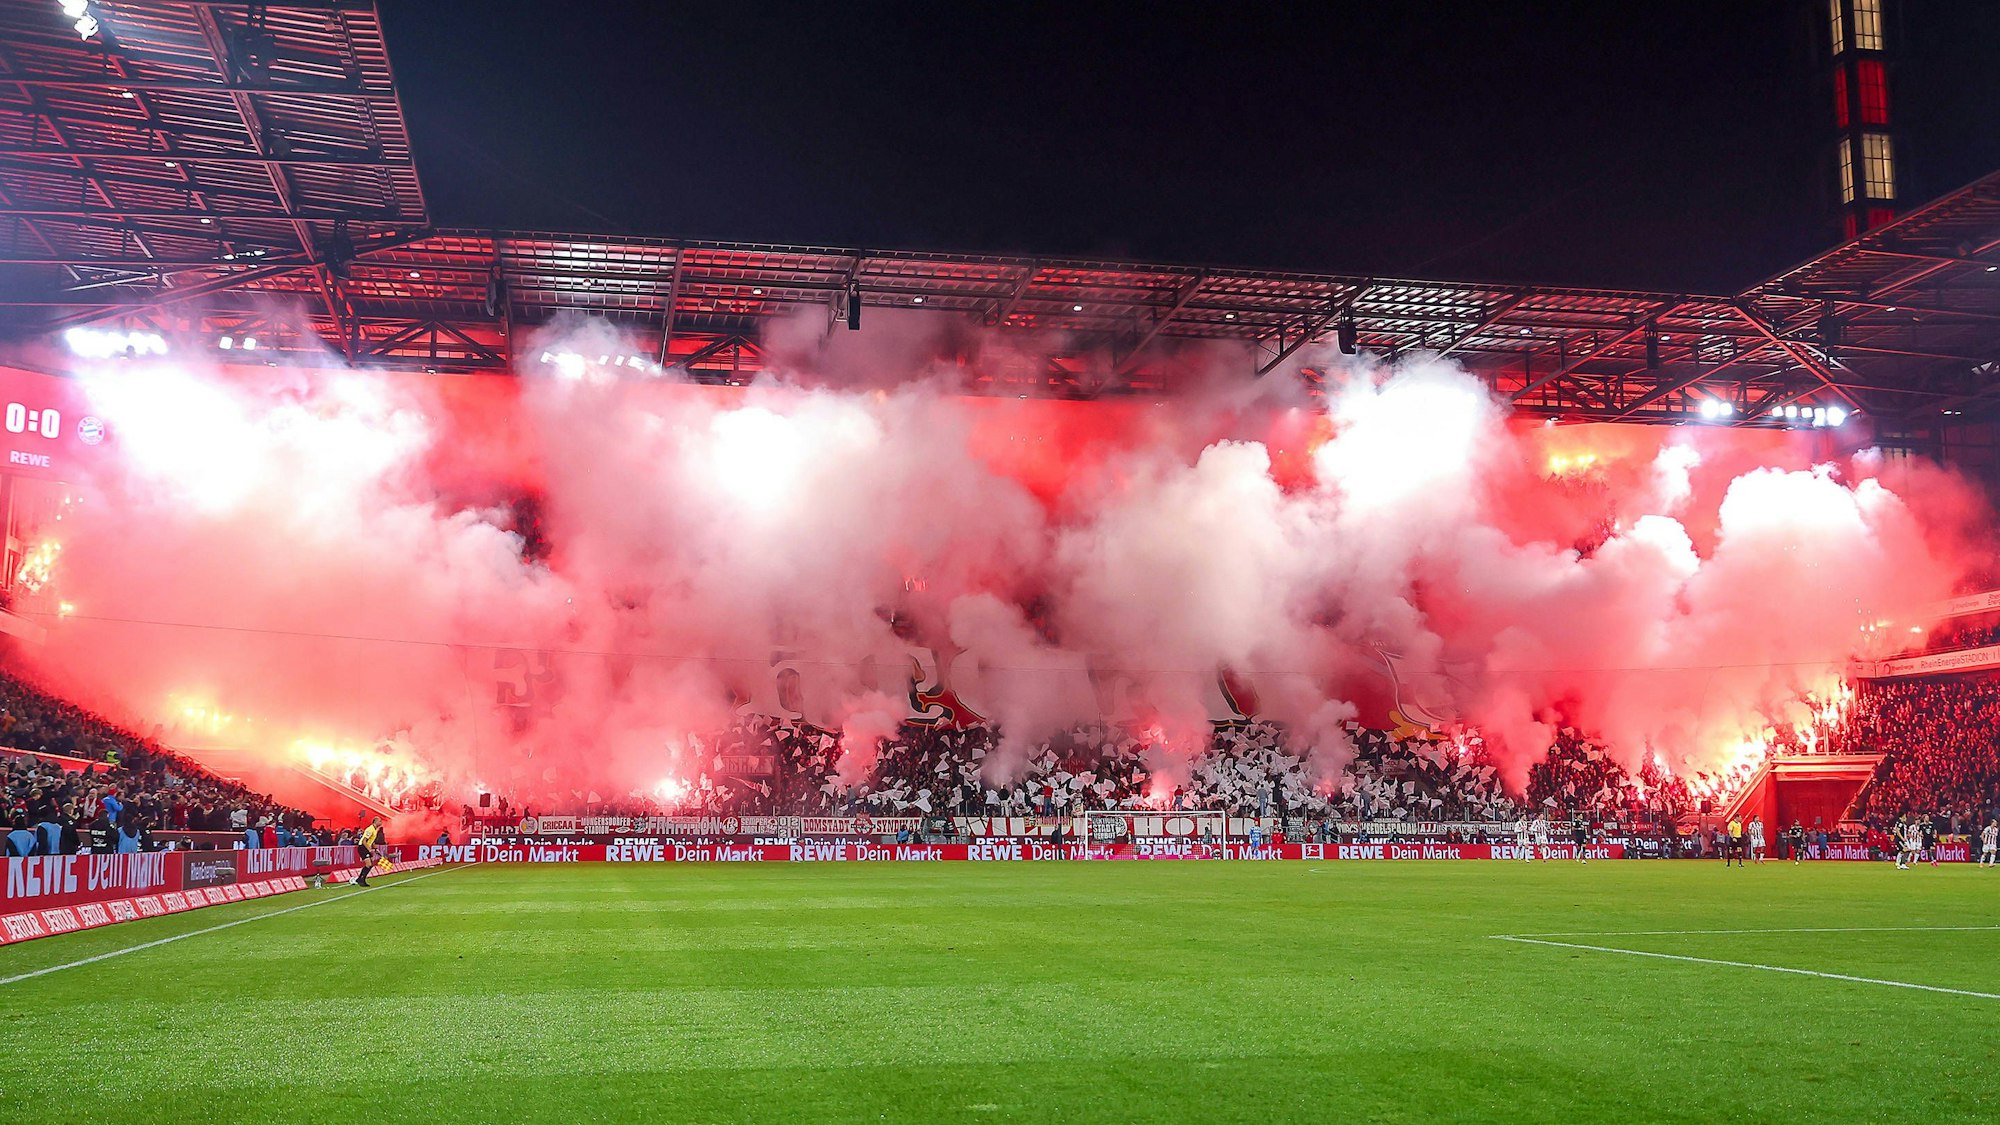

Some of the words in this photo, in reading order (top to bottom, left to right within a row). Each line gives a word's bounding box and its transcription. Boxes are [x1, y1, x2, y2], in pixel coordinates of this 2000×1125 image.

[5, 402, 60, 438] 0:0
[10, 450, 50, 467] REWE
[1921, 652, 1988, 668] RheinEnergieSTADION
[543, 820, 573, 830] CRICCAA
[740, 817, 768, 826] SEMPER
[803, 819, 850, 833] DOMSTADT
[1092, 824, 1116, 833] STADT
[1419, 823, 1436, 833] AJJ
[584, 825, 610, 835] STADION
[417, 845, 477, 863] REWE
[486, 845, 523, 862] Dein
[527, 845, 580, 863] Markt
[605, 845, 665, 862] REWE
[675, 844, 710, 862] Dein
[715, 846, 764, 862] Markt
[789, 845, 846, 861] REWE
[856, 845, 891, 861] Dein
[895, 846, 943, 861] Markt
[967, 845, 1023, 861] REWE
[1339, 846, 1385, 860] REWE
[1391, 846, 1419, 860] Dein
[1422, 846, 1460, 860] Markt
[1843, 845, 1869, 860] Markt
[1935, 847, 1966, 862] Markt
[41, 908, 81, 933] DERTOUR
[76, 903, 112, 927] DERTOUR
[2, 912, 46, 940] DERTOUR
